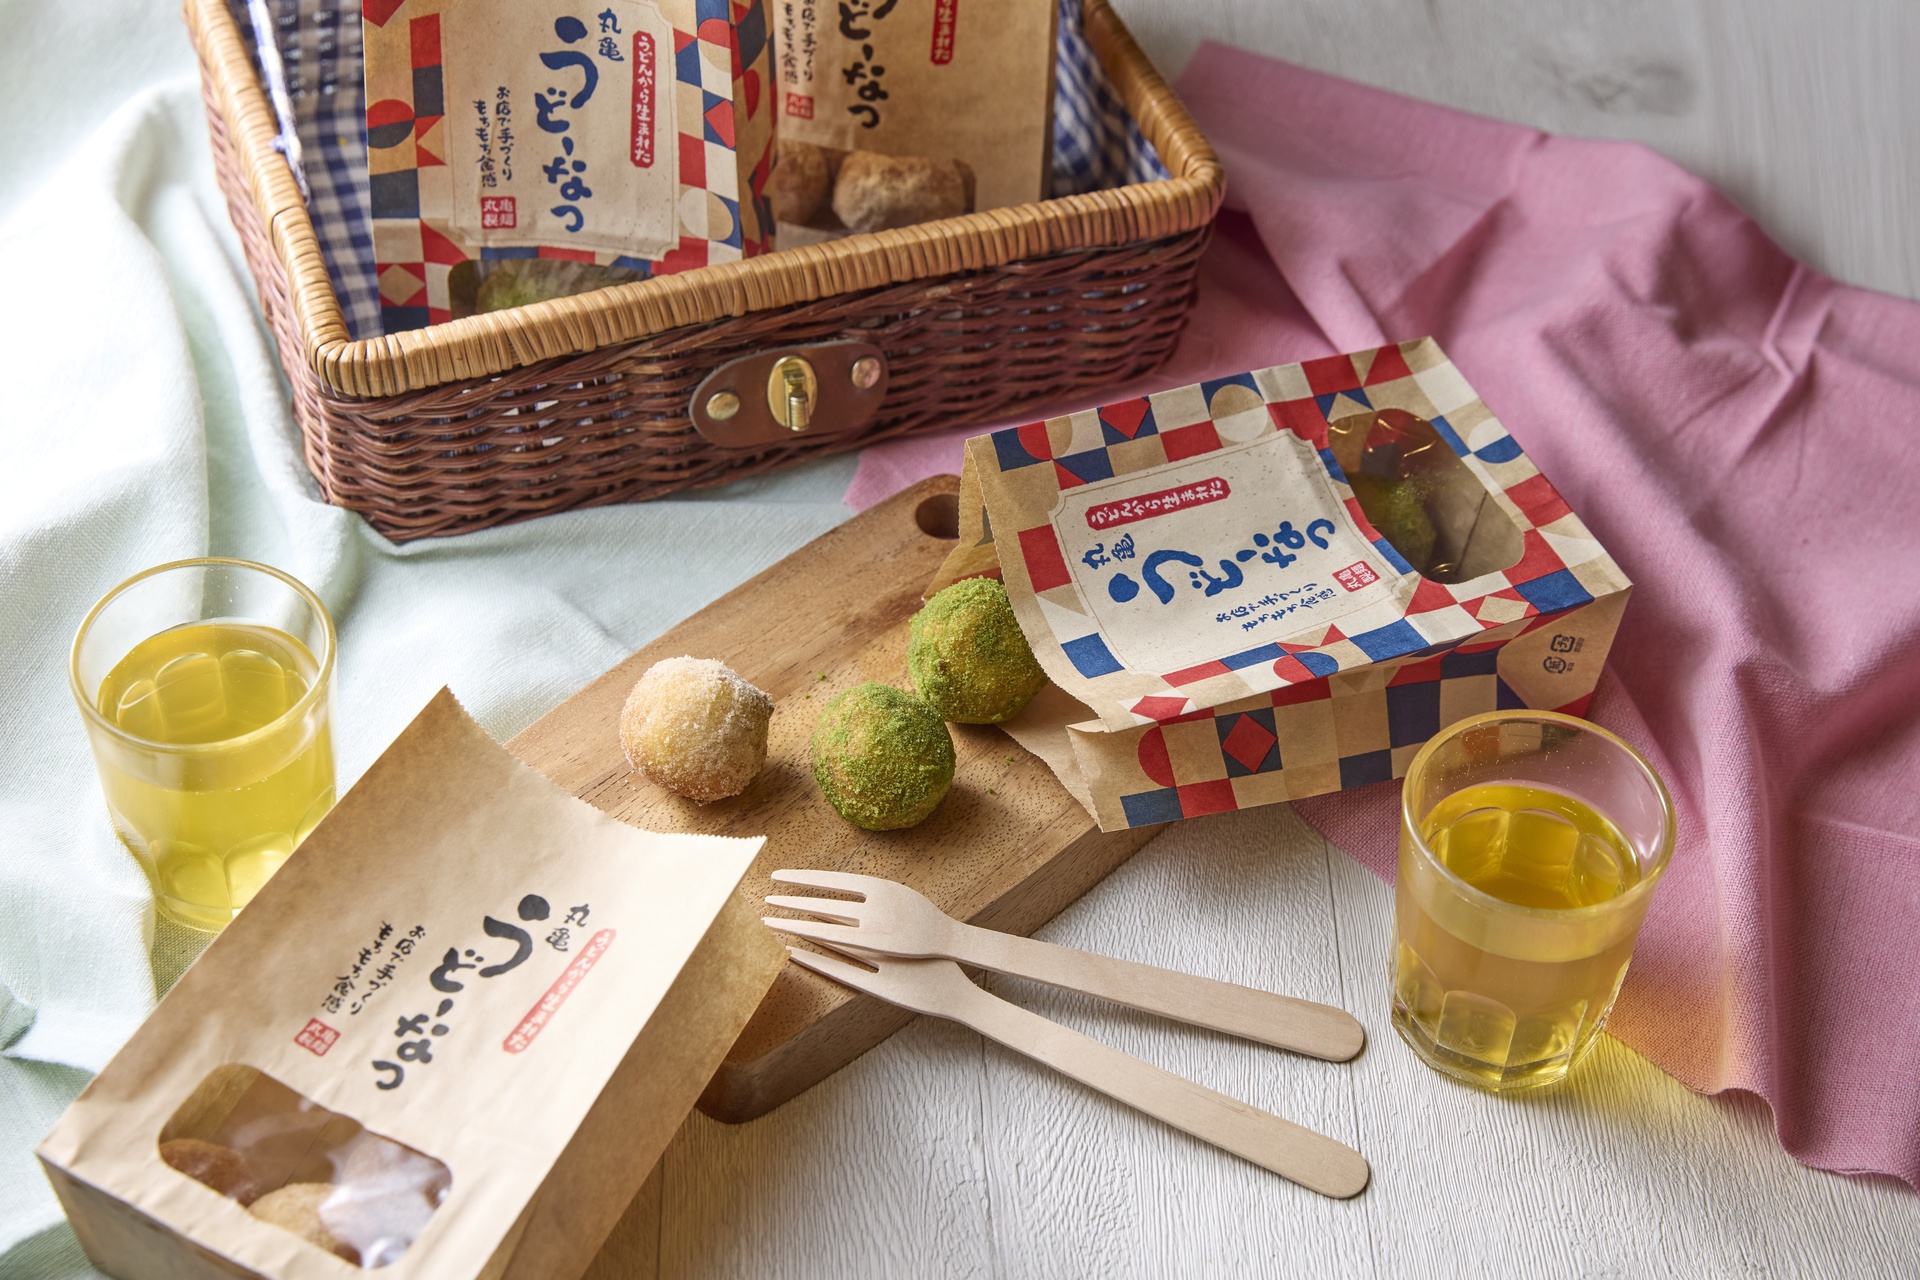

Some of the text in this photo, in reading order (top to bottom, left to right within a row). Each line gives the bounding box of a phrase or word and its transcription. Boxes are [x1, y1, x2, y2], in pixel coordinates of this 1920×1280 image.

[597, 8, 624, 62] 丸亀
[839, 0, 898, 128] どーなつ
[496, 86, 514, 181] お店で手づくり
[635, 36, 653, 163] うどんから生まれた
[473, 99, 497, 188] もちもち食感
[1091, 479, 1223, 524] うどんから生まれた
[1082, 533, 1135, 570] 丸亀
[1216, 583, 1317, 623] お店で手づくり
[1241, 588, 1337, 632] もちもち食感
[546, 904, 590, 952] 丸亀
[321, 920, 393, 1014] もちもち食感
[350, 925, 426, 1015] お店で手づくり
